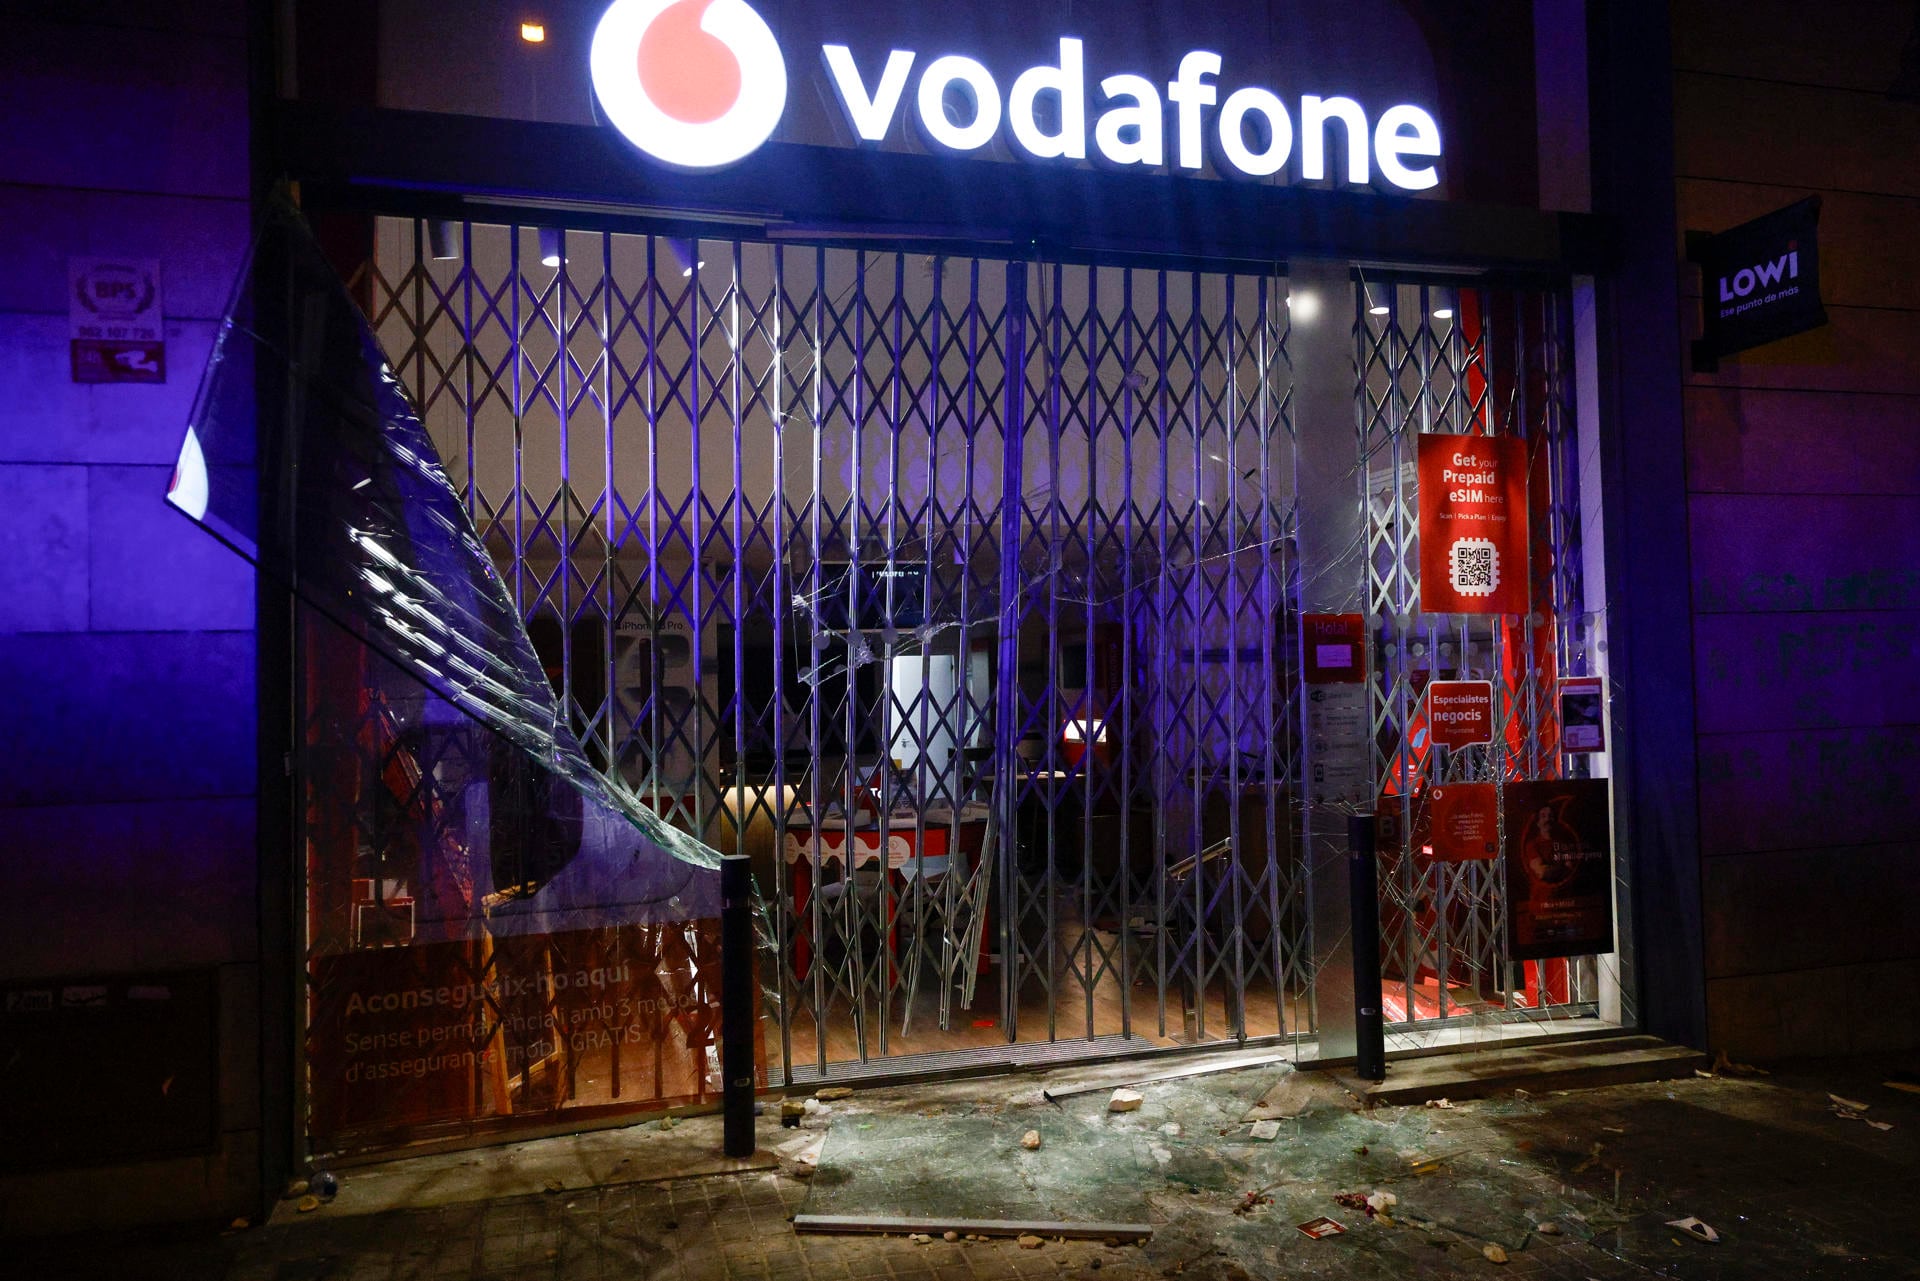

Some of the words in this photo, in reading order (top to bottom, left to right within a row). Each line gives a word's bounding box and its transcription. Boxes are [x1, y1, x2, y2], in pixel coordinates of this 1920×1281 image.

[821, 36, 1441, 192] vodafone
[1736, 299, 1763, 316] punto
[1764, 293, 1777, 303] de
[1452, 452, 1477, 467] Get
[1478, 459, 1499, 469] your
[1443, 469, 1496, 487] Prepaid
[1449, 488, 1484, 503] eSIM
[1484, 494, 1504, 503] here
[621, 621, 654, 631] iPhon
[667, 620, 684, 631] Pro
[1315, 620, 1349, 635] Hola!
[1433, 694, 1489, 706] Especialistes
[1433, 709, 1482, 725] negocis
[575, 959, 631, 990] aquí
[344, 1030, 414, 1053] Sense
[570, 1000, 614, 1025] amb
[619, 1001, 632, 1018] 3
[570, 1023, 642, 1052] GRATIS
